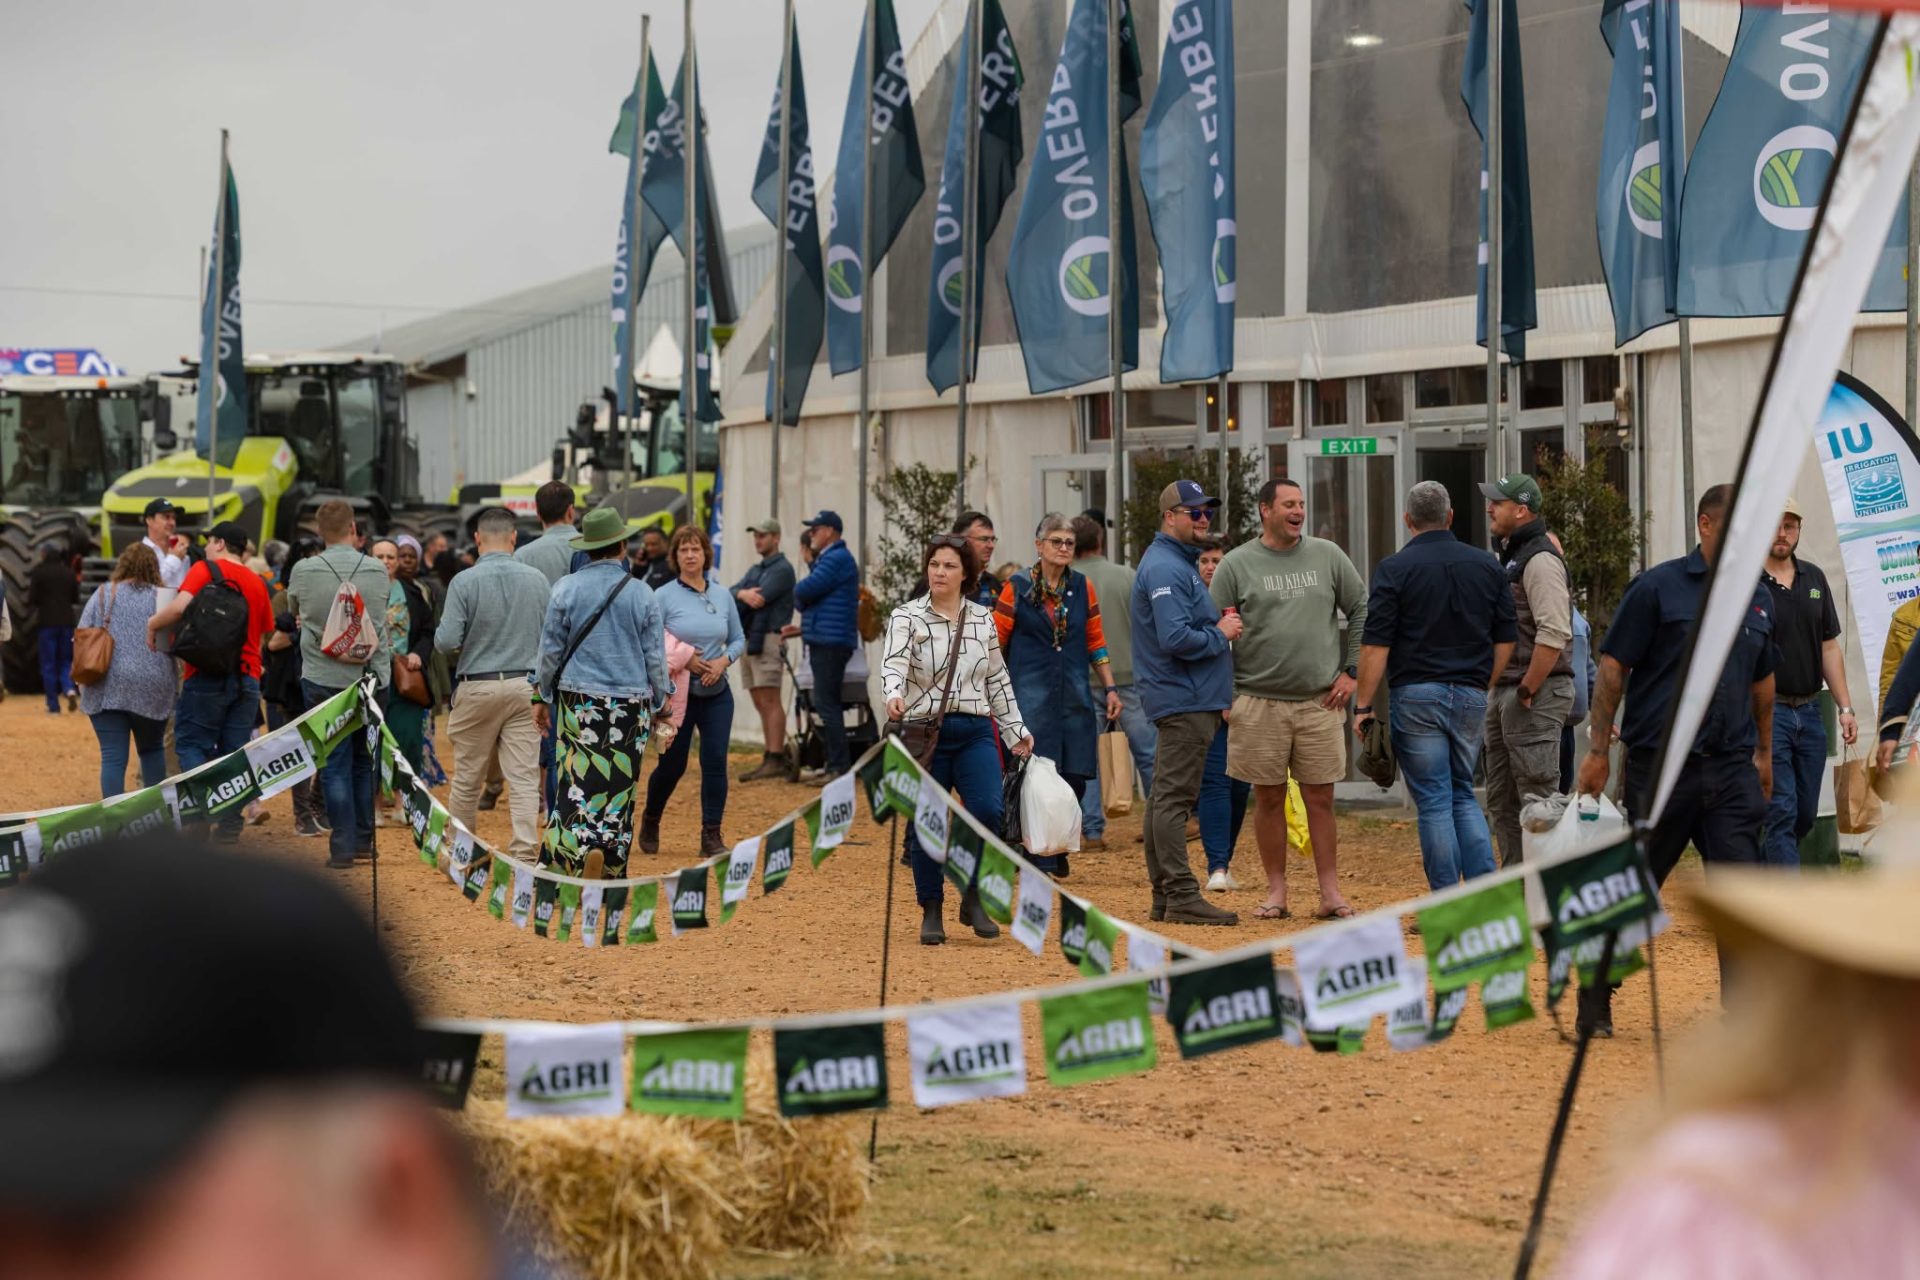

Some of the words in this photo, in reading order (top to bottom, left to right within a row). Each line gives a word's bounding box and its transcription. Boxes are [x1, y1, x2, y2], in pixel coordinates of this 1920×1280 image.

[1328, 440, 1369, 454] EXIT
[1827, 422, 1873, 460] IU
[1845, 454, 1897, 473] IRRIGATION
[1856, 502, 1907, 517] UNLIMITED
[1263, 575, 1283, 591] OLD
[1285, 570, 1318, 590] KHAKI
[1882, 572, 1916, 585] VYRSA
[256, 748, 305, 785] AGRI
[206, 770, 253, 809] AGRI
[824, 801, 853, 828] AGRI
[53, 826, 102, 853] AGRI
[674, 890, 704, 911] AGRI
[1559, 865, 1642, 924] AGRI
[1437, 915, 1523, 969] AGRI
[1316, 954, 1397, 998] AGRI
[1184, 986, 1272, 1034] AGRI
[1056, 1015, 1145, 1060] AGRI
[522, 1060, 611, 1097] AGRI
[642, 1054, 735, 1097] AGRI
[785, 1055, 880, 1095] AGRI
[926, 1041, 1013, 1082] AGRI
